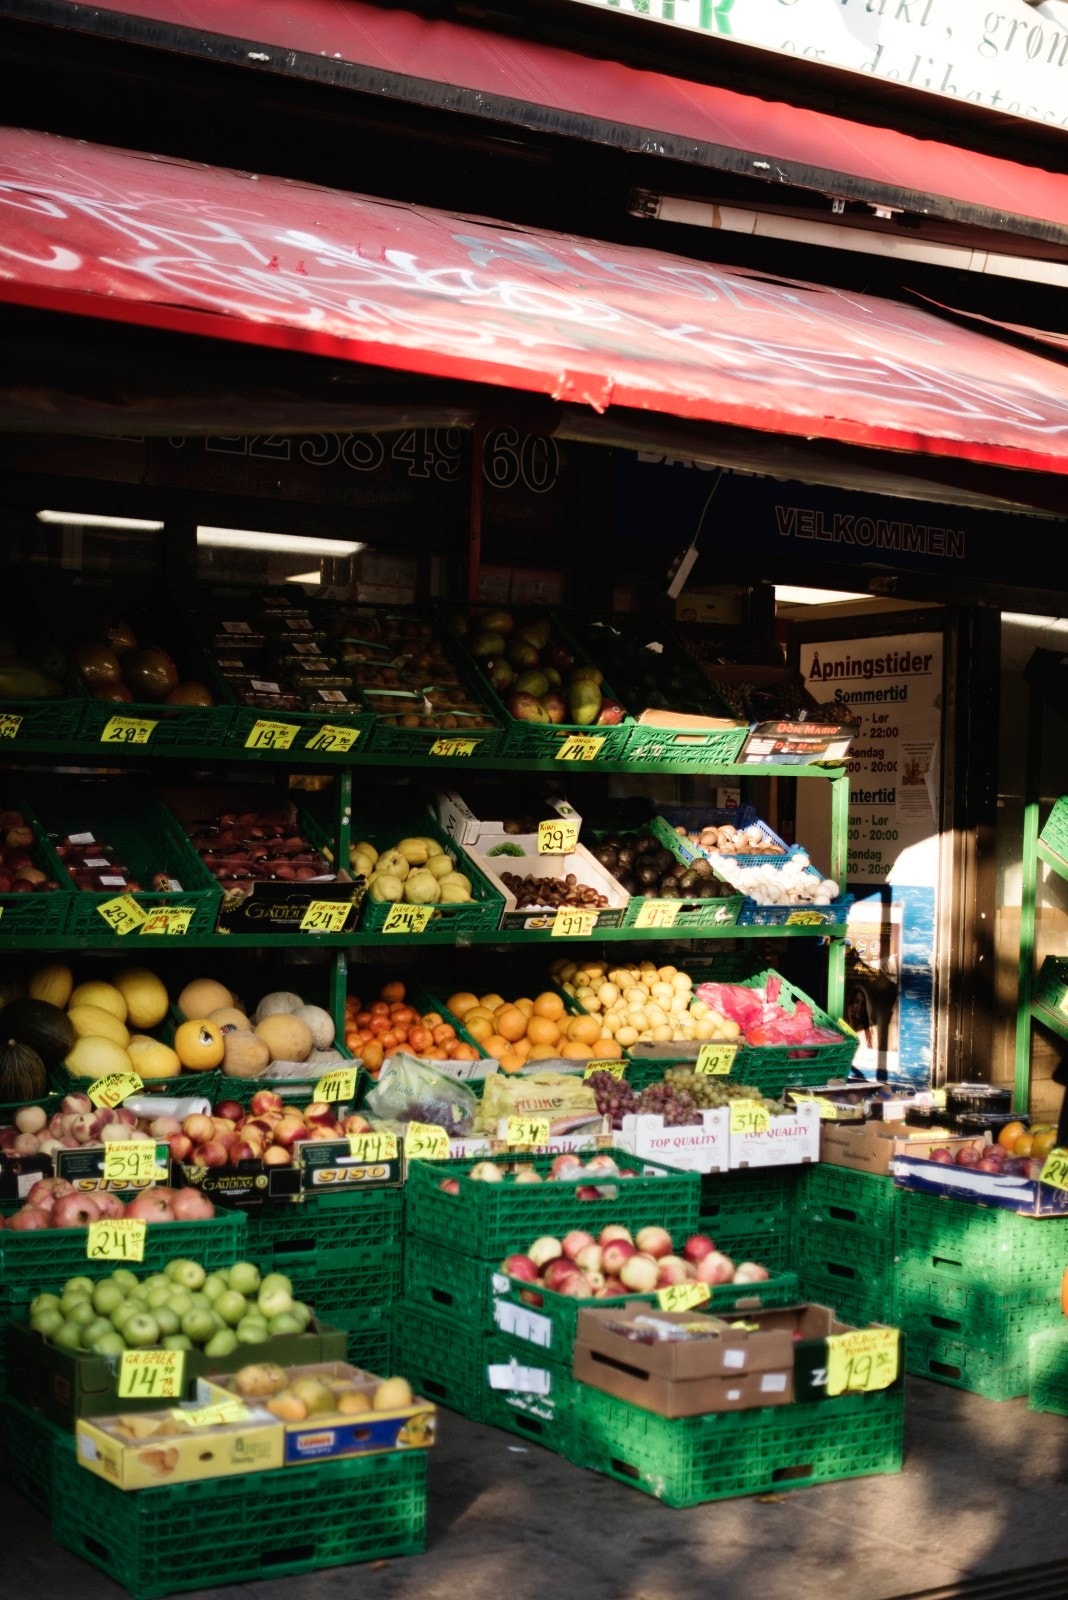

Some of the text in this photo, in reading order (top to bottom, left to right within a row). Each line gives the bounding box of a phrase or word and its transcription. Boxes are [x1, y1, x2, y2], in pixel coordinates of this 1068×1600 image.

[483, 424, 560, 494] 60
[774, 505, 966, 559] VELKOMMEN
[809, 651, 933, 681] Åpningstider
[834, 684, 908, 703] Sommertid
[253, 730, 276, 747] 19
[870, 726, 899, 739] 22:00
[561, 744, 585, 760] 14
[542, 830, 564, 851] 29
[869, 829, 899, 841] 20:00
[868, 863, 892, 875] 20:0
[103, 905, 128, 924] 29
[245, 902, 305, 919] GAUDI
[305, 911, 333, 929] 24
[143, 914, 170, 932] 29
[385, 913, 414, 931] 24
[562, 916, 583, 935] 99
[701, 1056, 720, 1073] 19
[98, 1088, 121, 1109] 16
[321, 1080, 341, 1101] 44
[511, 1123, 540, 1142] 34
[732, 1112, 759, 1134] 34
[767, 1126, 809, 1139] QUALITY
[357, 1135, 382, 1161] 44
[651, 1134, 719, 1148] TOP QUALITY
[107, 1152, 140, 1178] 39
[317, 1165, 386, 1183] SISO
[1043, 1159, 1068, 1184] 24
[78, 1178, 151, 1192] SISO
[91, 1231, 127, 1258] 24
[127, 1366, 158, 1395] 14
[844, 1355, 873, 1390] 19
